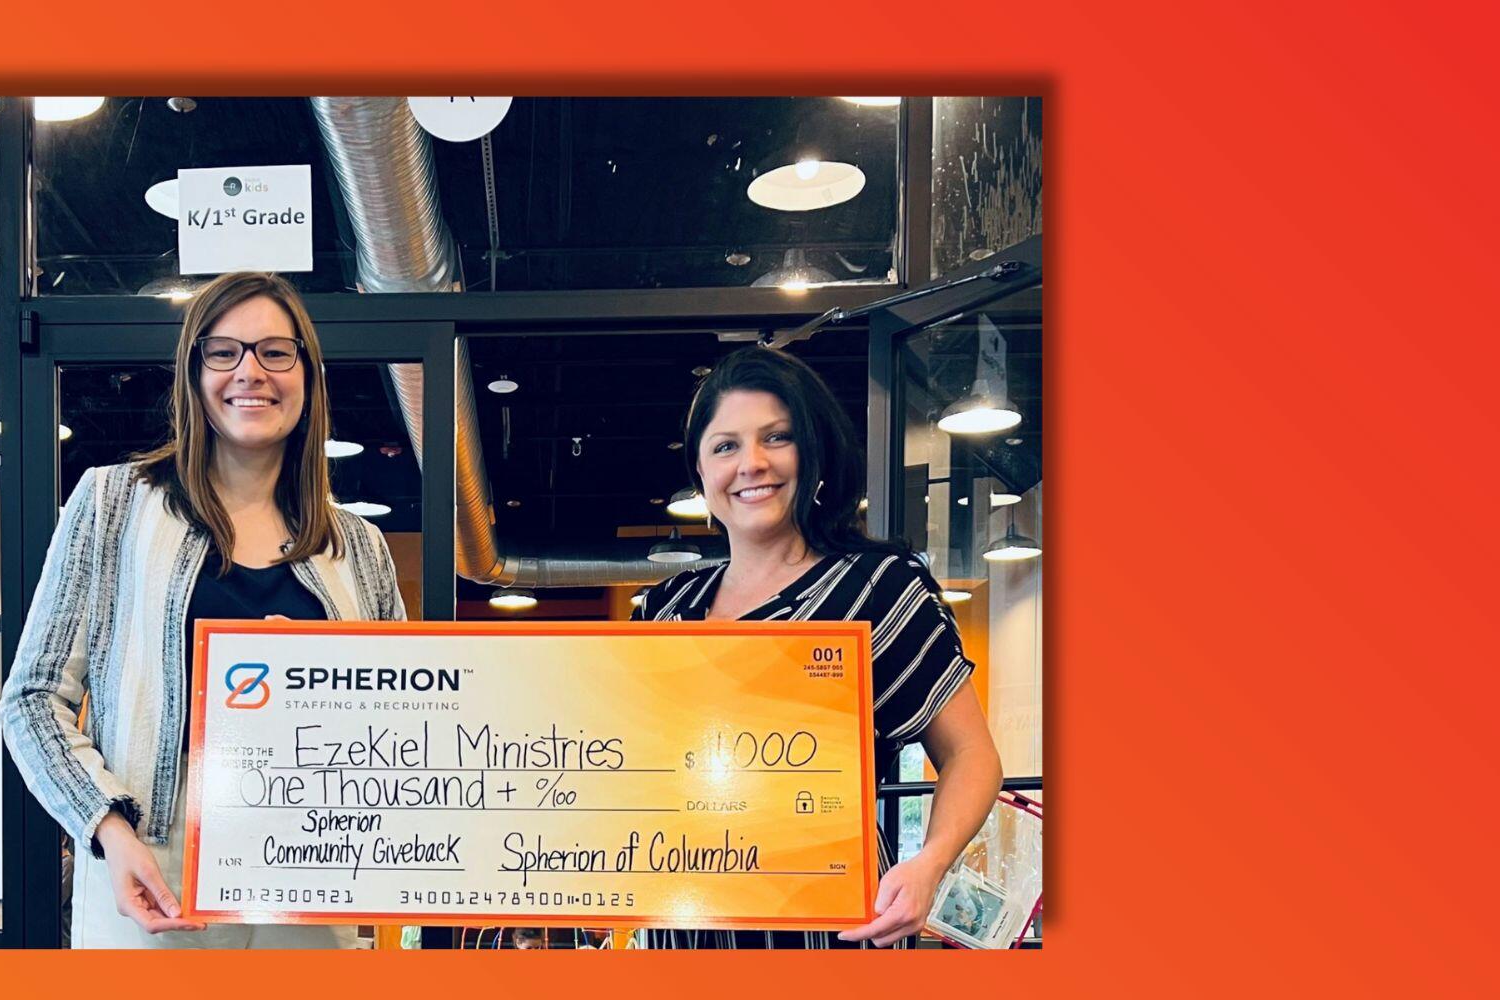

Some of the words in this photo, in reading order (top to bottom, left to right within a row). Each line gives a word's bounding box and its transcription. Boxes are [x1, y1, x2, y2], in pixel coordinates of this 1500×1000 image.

[244, 182, 269, 193] kids
[242, 207, 305, 225] Grade
[813, 647, 842, 662] 001
[285, 700, 352, 710] STAFFING
[359, 700, 367, 710] &
[374, 701, 460, 711] RECRUITING
[241, 746, 254, 756] TO
[256, 747, 274, 756] THE
[456, 723, 624, 770] Ministries
[256, 760, 269, 769] OF
[685, 751, 695, 769] $
[240, 767, 304, 806] One
[313, 769, 486, 810] Thousand
[686, 800, 747, 812] DOLLARS
[301, 809, 382, 837] Spherion
[218, 856, 242, 866] FOR
[264, 835, 363, 880] Community
[501, 831, 606, 887] Spherion
[615, 830, 640, 873] of
[649, 829, 761, 873] Columbia
